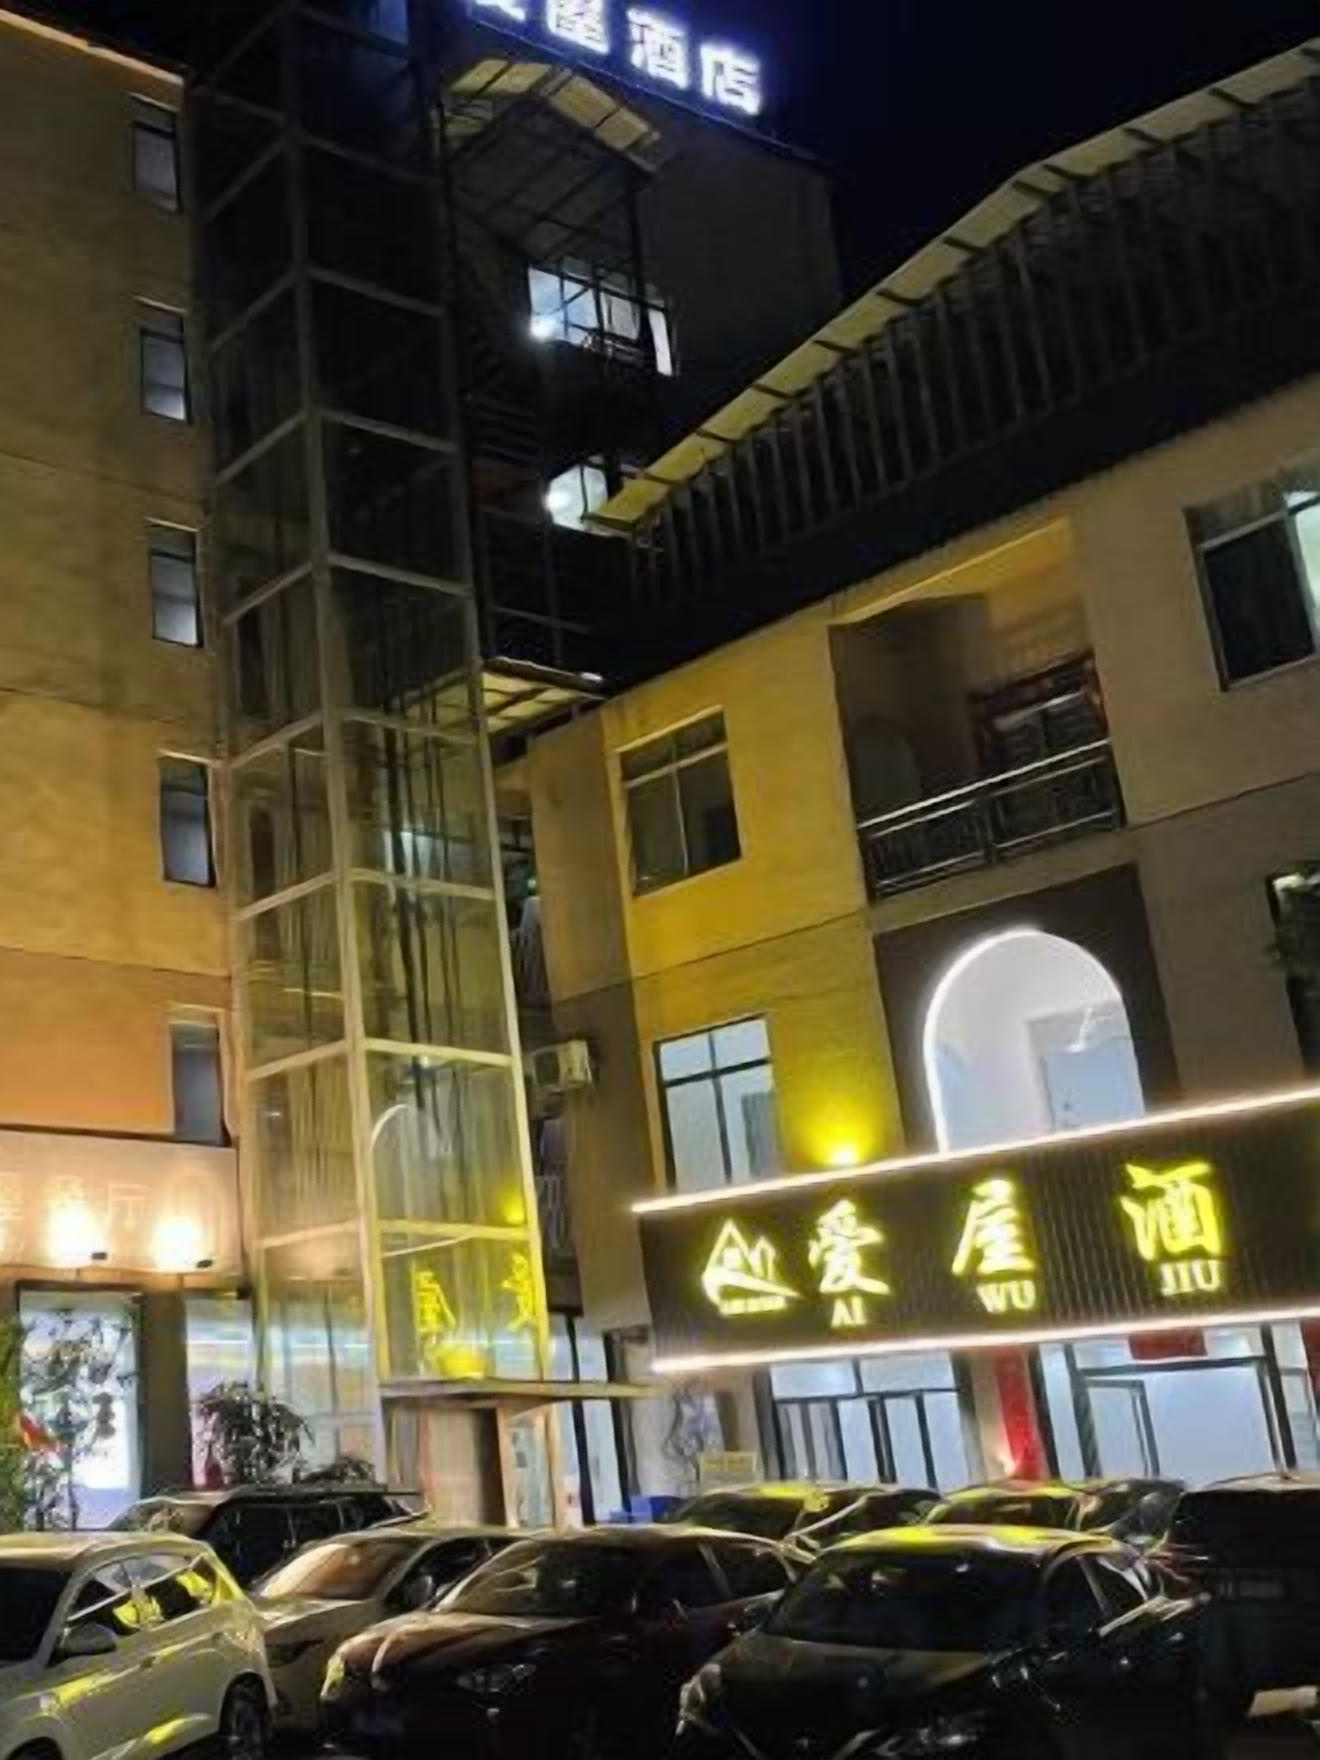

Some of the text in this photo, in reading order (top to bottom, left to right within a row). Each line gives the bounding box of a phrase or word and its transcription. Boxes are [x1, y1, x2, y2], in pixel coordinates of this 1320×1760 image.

[475, 0, 759, 114] 屋酒店
[831, 1260, 1221, 1328] AI WU JIU
